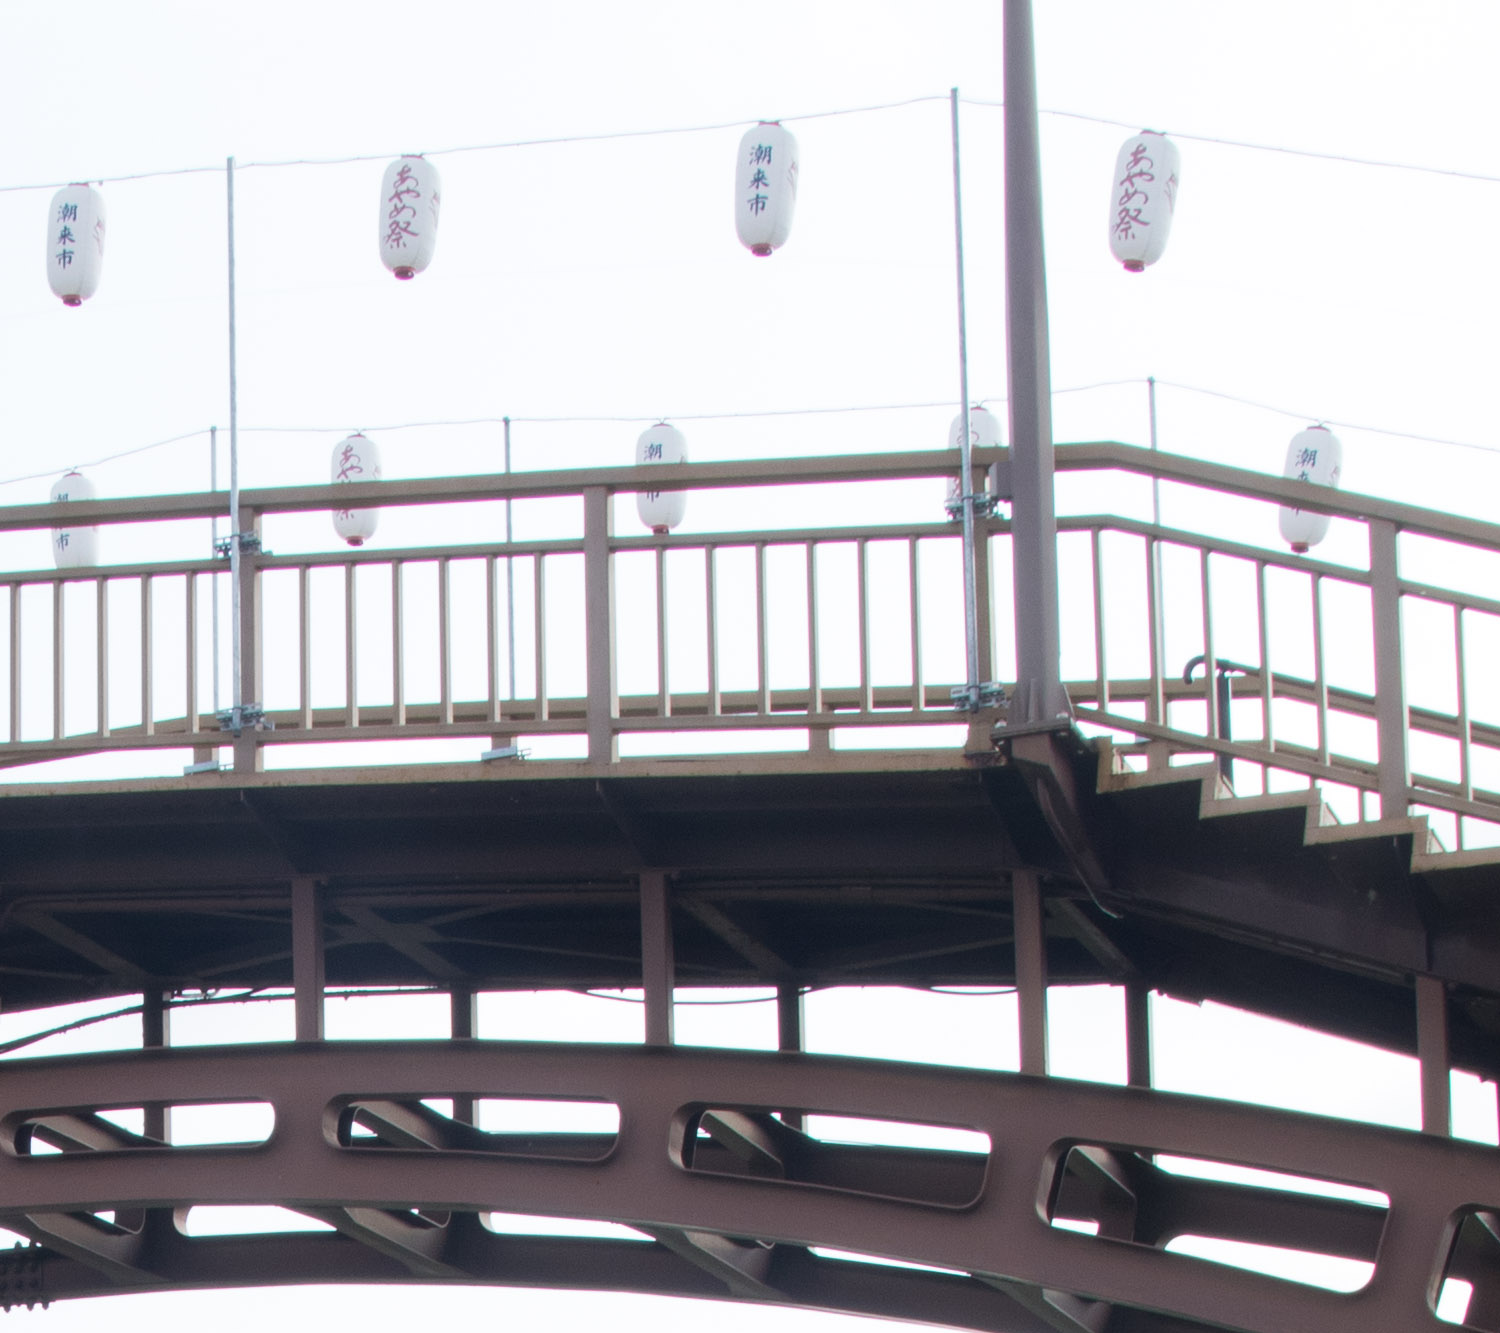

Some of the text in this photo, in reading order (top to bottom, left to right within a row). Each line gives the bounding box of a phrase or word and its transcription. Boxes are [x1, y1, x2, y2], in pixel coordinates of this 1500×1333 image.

[385, 164, 421, 249] あやめ祭
[746, 144, 773, 216] 潮来市
[1112, 143, 1155, 240] あやめ祭
[56, 203, 78, 269] 潮来市
